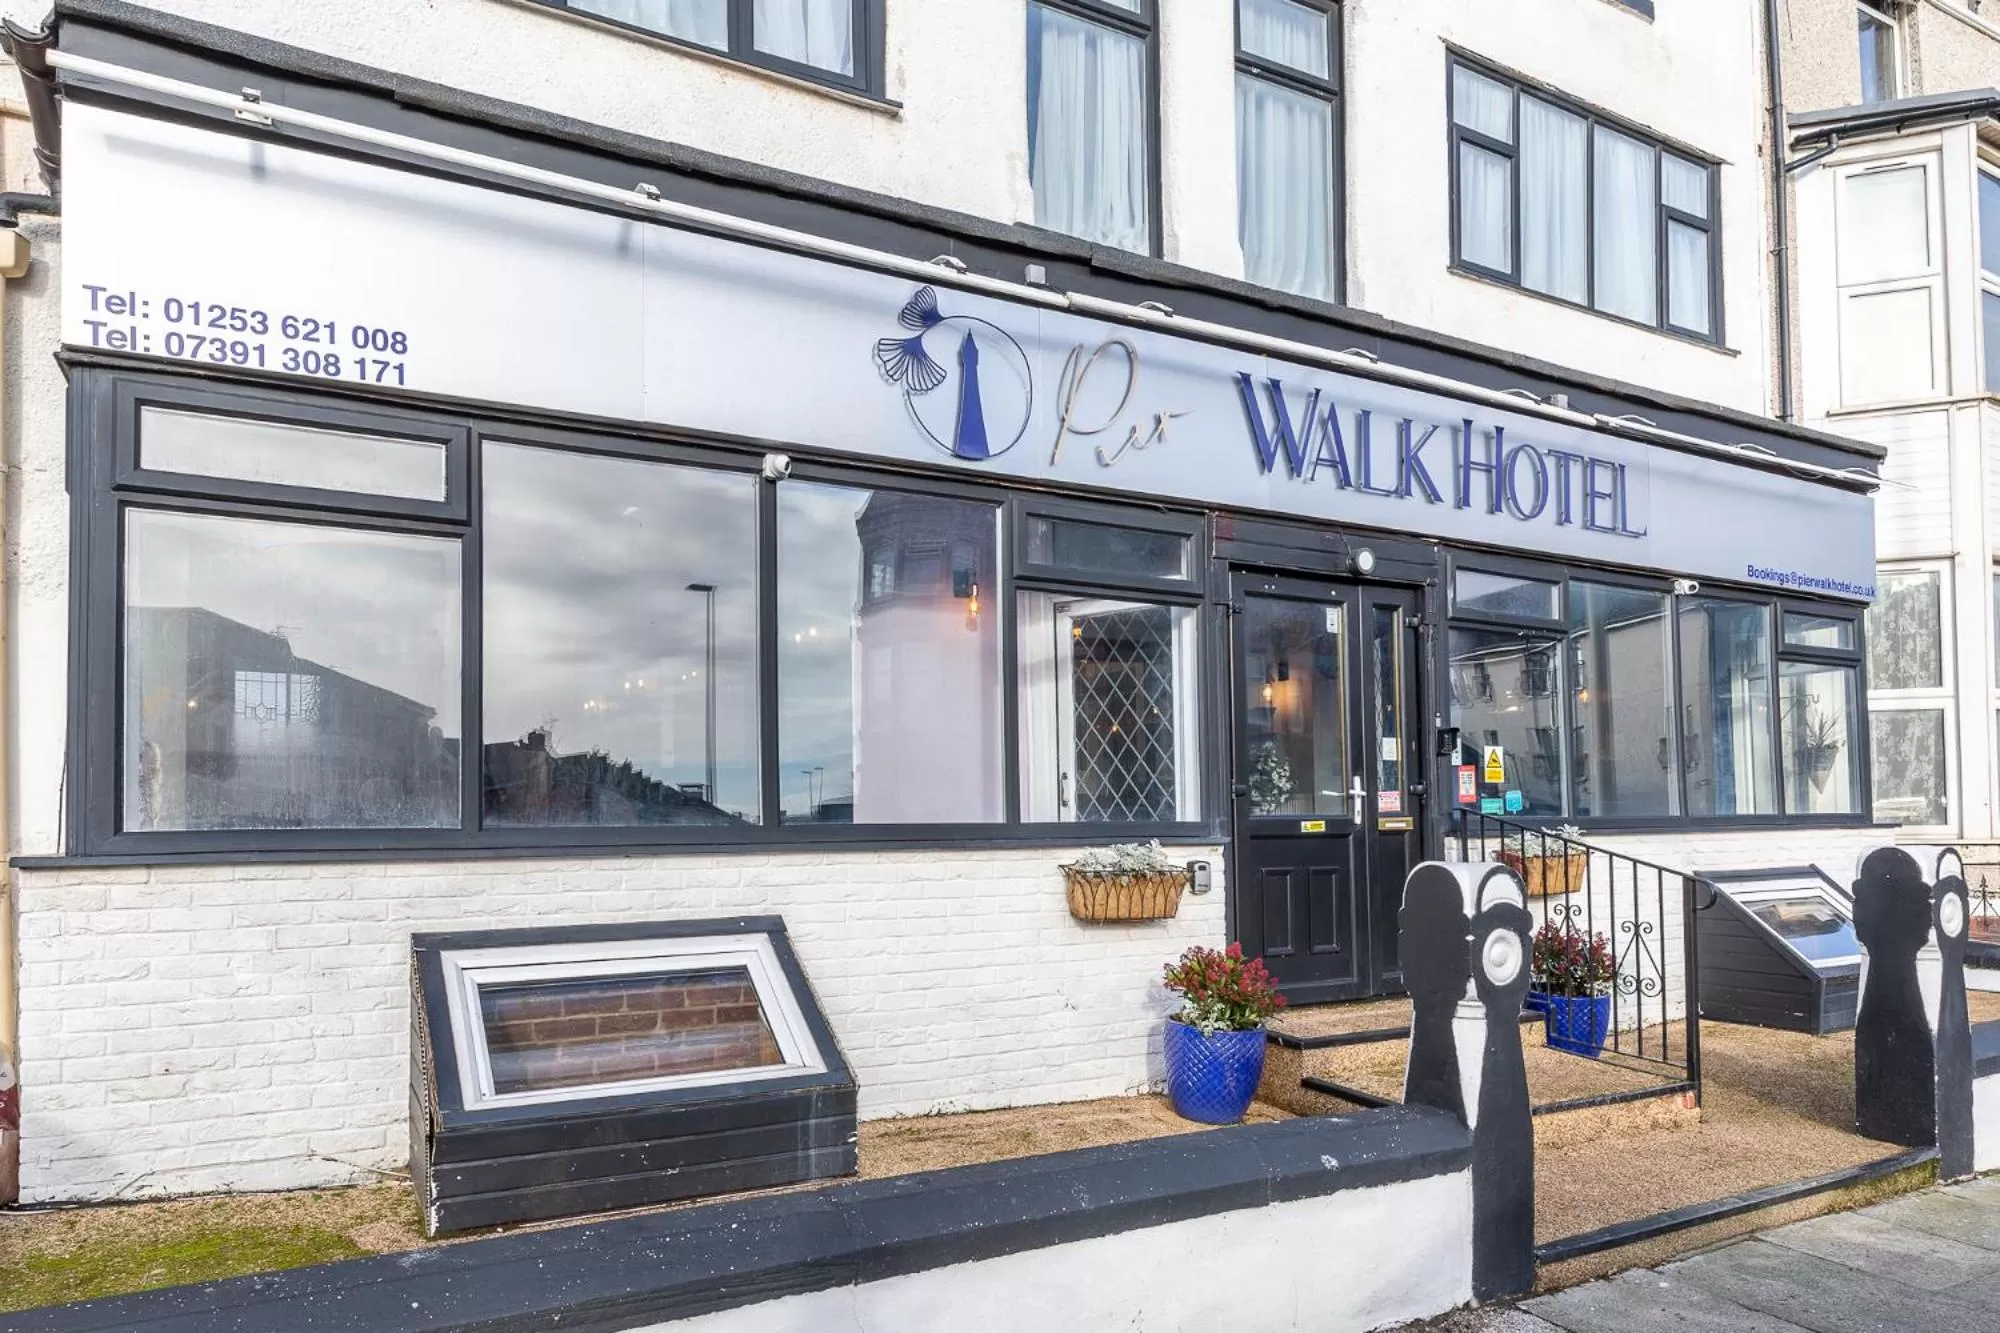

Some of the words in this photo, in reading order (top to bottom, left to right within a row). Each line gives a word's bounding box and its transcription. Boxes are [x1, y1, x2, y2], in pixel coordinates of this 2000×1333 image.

[82, 284, 150, 319] Tel:
[163, 297, 269, 335] 01253
[281, 315, 336, 345] 621
[351, 325, 408, 355] 008
[83, 319, 151, 353] Tel:
[164, 331, 266, 368] 07391
[281, 347, 341, 377] 308
[353, 358, 405, 386] 171
[1746, 564, 1877, 598] Bookings@pierwalkhotel.co.uk
